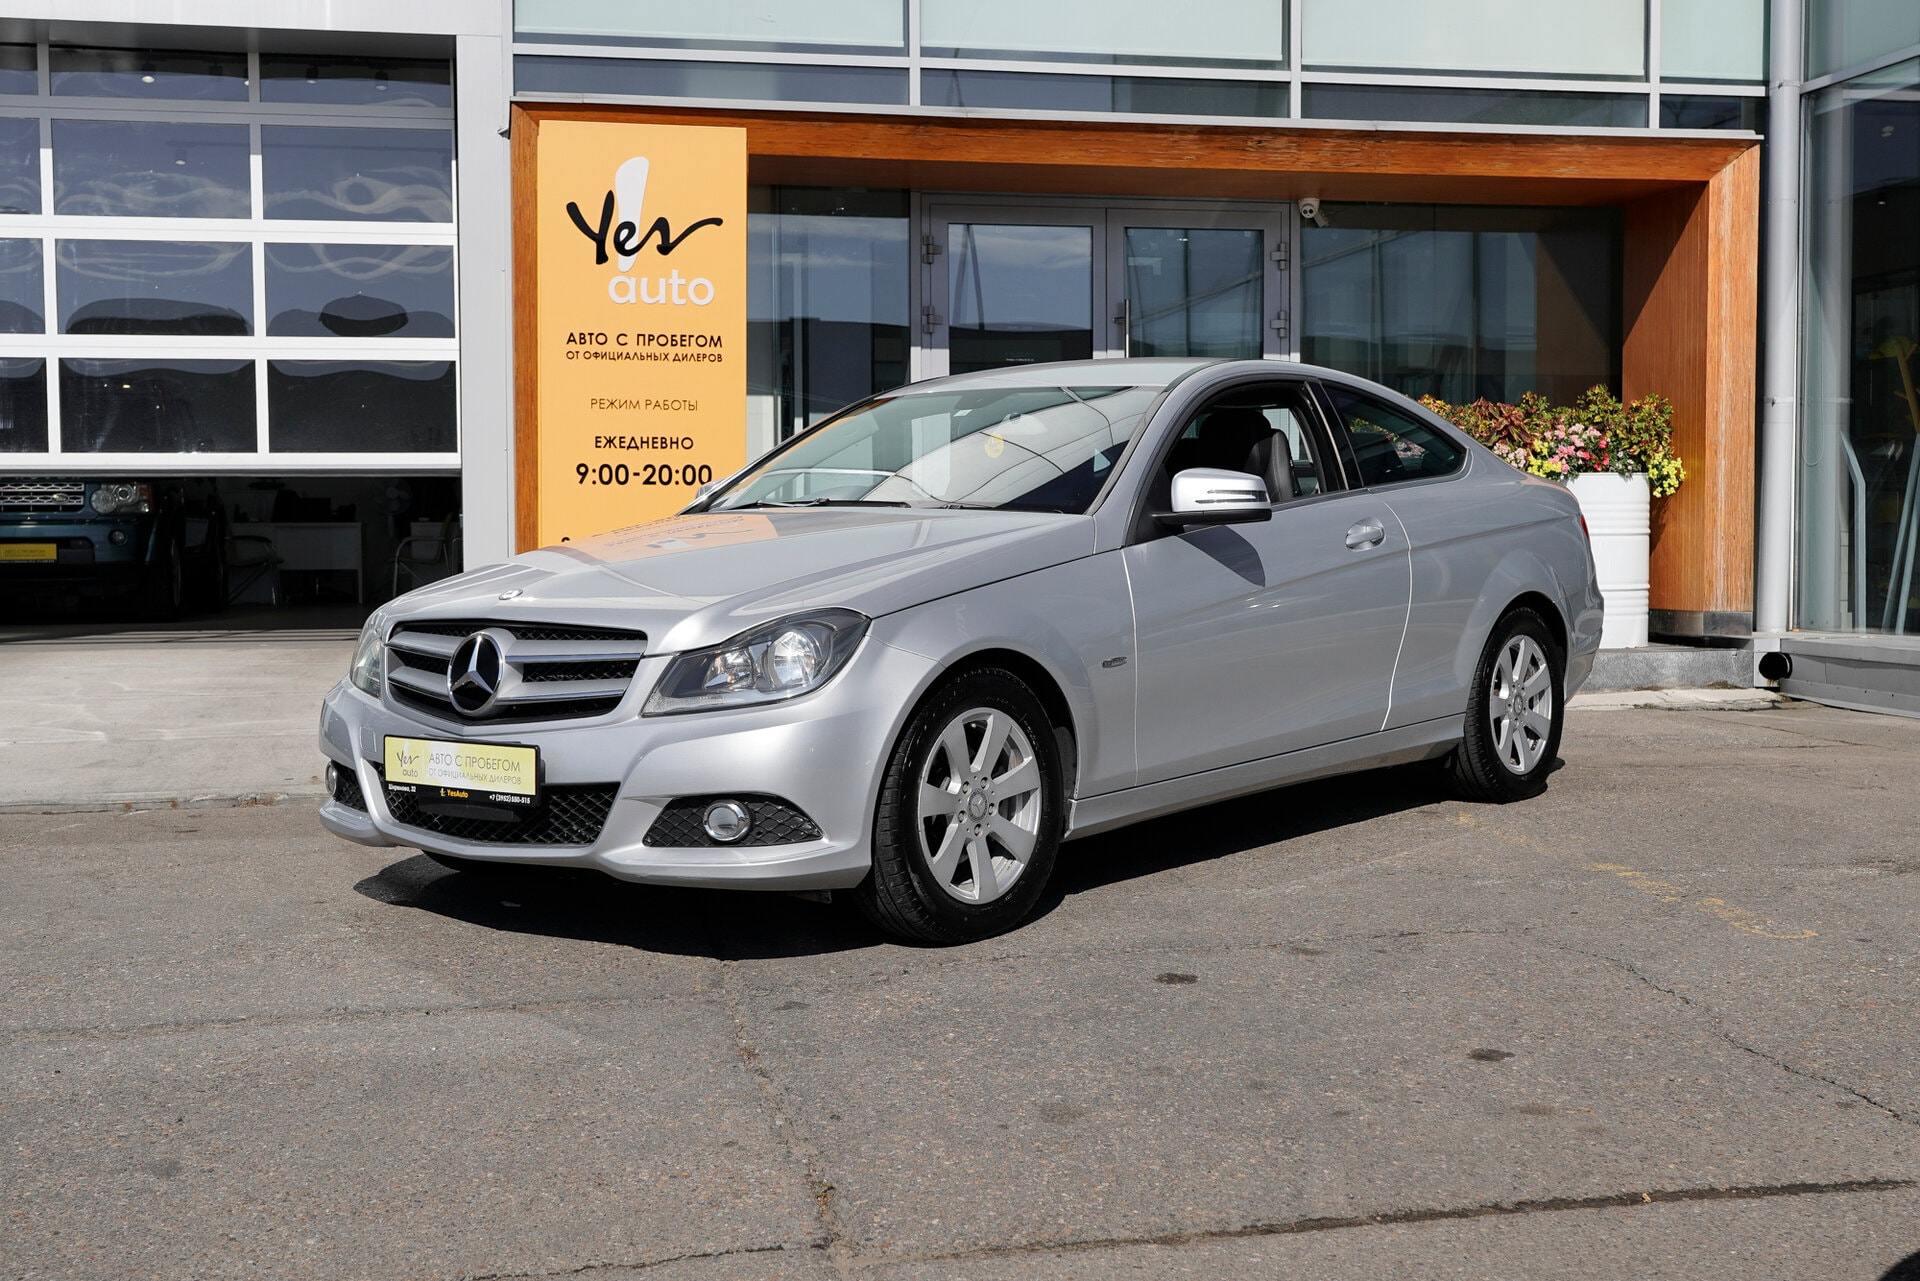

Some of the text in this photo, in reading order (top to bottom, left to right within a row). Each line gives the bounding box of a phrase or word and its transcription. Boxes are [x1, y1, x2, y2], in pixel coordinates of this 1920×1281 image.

[566, 189, 723, 265] Yes
[608, 269, 715, 306] auto
[566, 332, 723, 348] АВТО С ПРОБЕГОМ
[566, 351, 723, 363] ОТ ОФИЦИАЛЬНЫХ ДИЛЕРОВ
[590, 398, 698, 411] РЕЖИМ РАБОТЫ
[594, 436, 694, 451] ЕЖЕДНЕВНО
[576, 463, 713, 486] 9:00-20:00
[428, 753, 521, 772] АВТО С ПРОБЕГОМ
[402, 769, 418, 777] auto
[428, 768, 521, 785] ОТ ОФИЦИАЛЬНЫХ ДИЛЕРОВ
